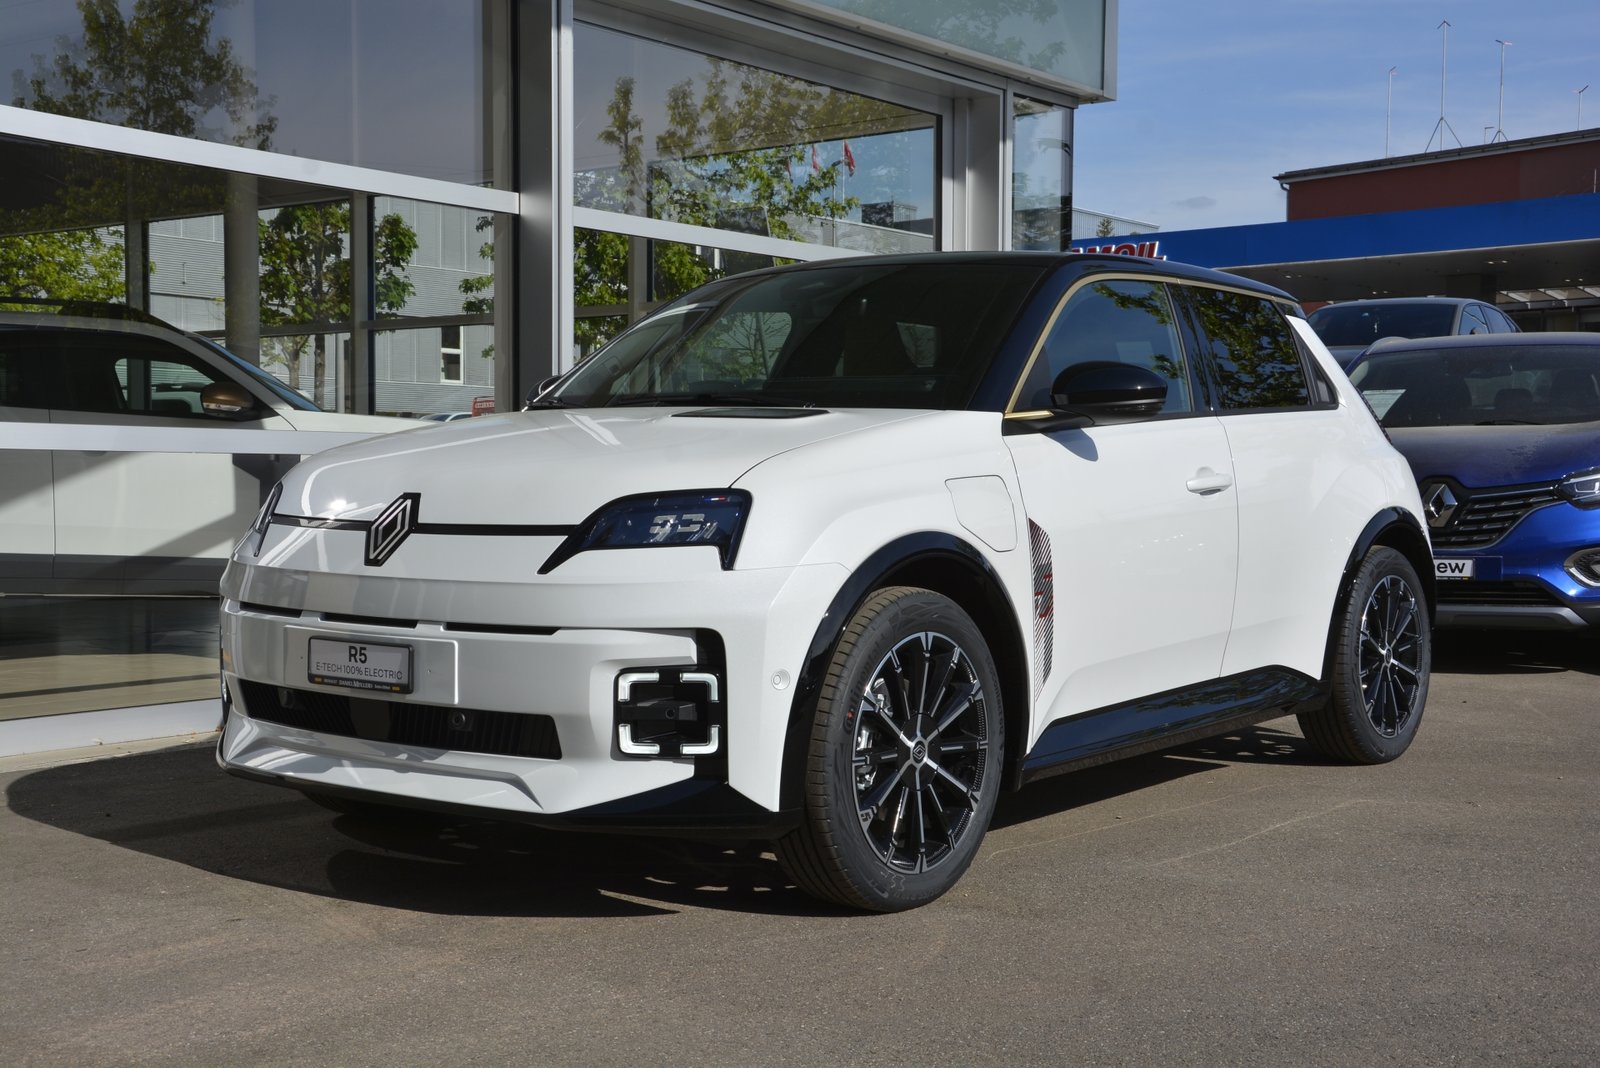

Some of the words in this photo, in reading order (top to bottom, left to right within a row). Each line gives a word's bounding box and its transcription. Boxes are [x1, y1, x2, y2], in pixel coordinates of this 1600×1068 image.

[1436, 562, 1465, 574] ew
[348, 645, 368, 664] R5
[316, 661, 342, 673] E-TECH
[343, 664, 363, 676] 100%
[364, 667, 403, 680] ELECTRIC
